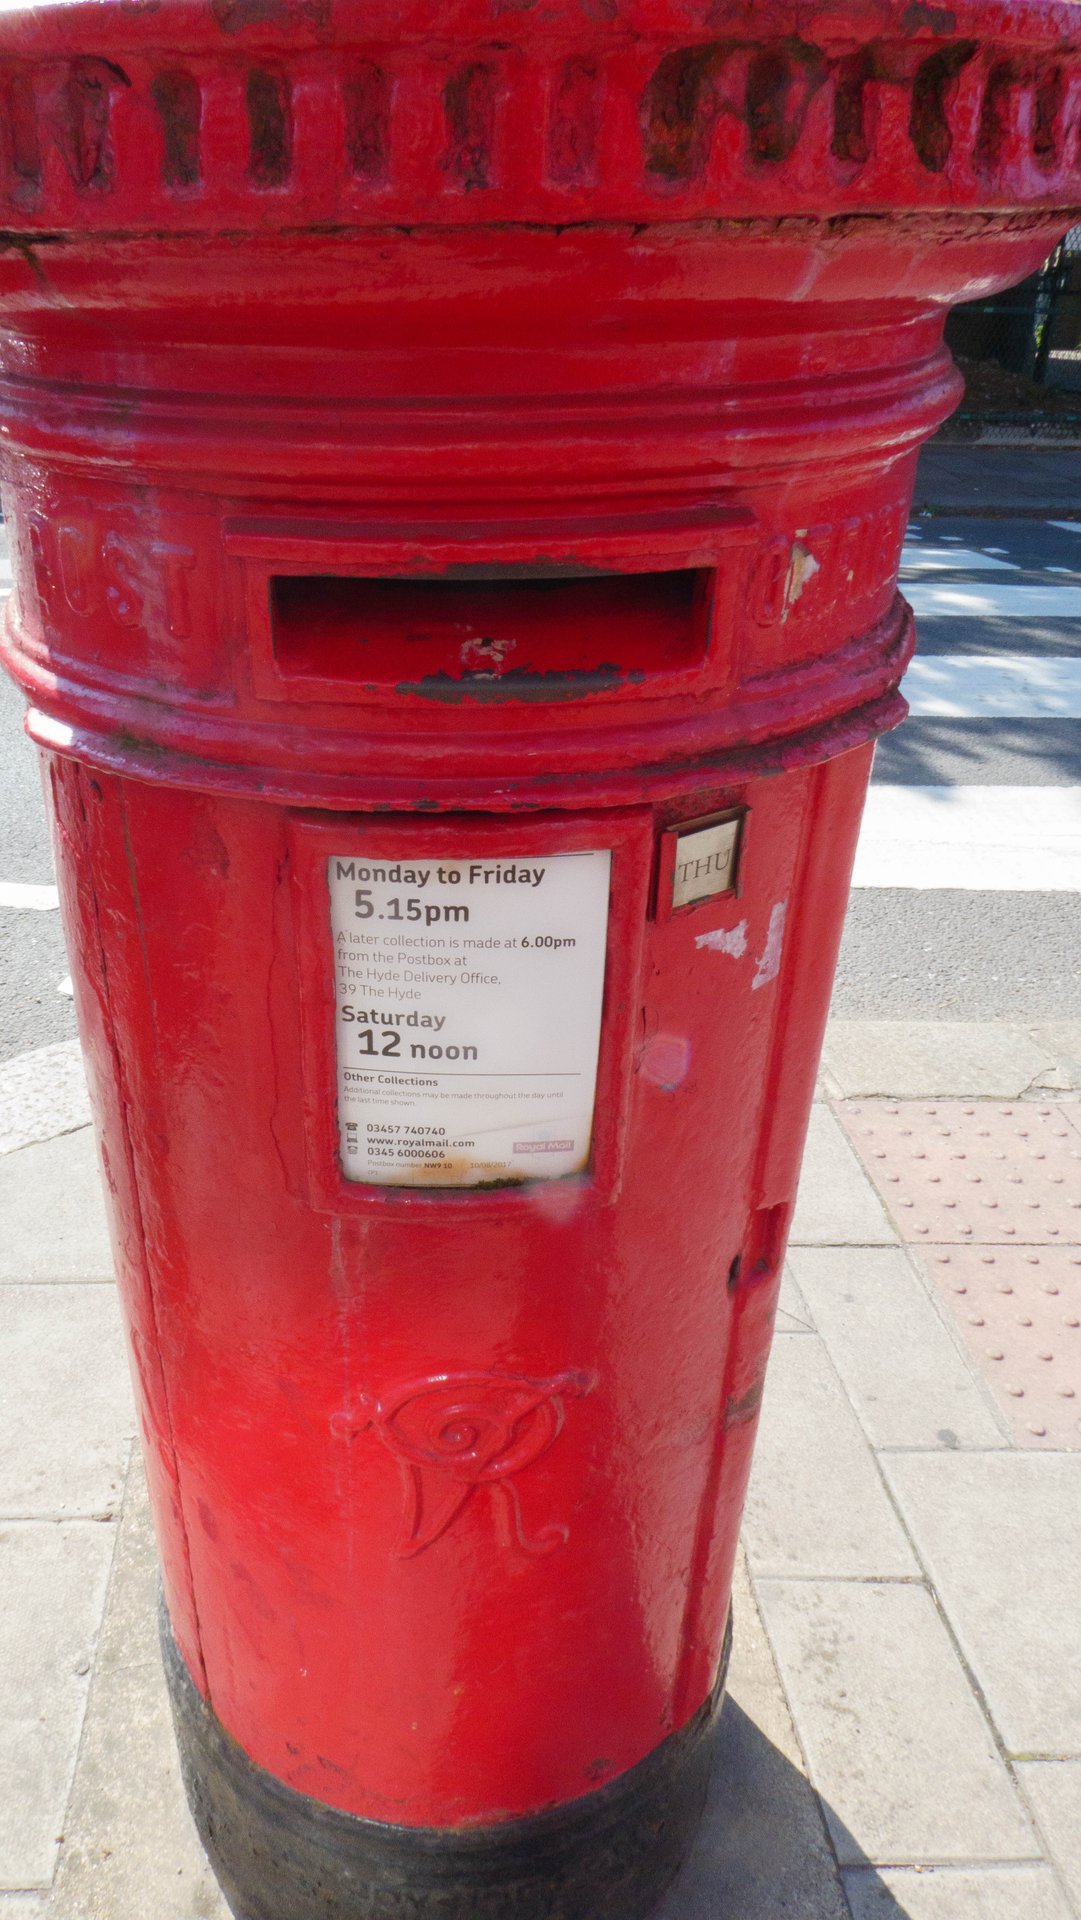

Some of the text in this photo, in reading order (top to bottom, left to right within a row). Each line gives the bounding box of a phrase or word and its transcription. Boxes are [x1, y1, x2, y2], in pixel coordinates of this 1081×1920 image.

[678, 848, 732, 883] THU
[336, 862, 546, 888] Monday to Friday
[354, 889, 470, 926] 5.15pm
[337, 931, 576, 950] A later collection is made at 6.00pm
[338, 949, 468, 967] from the Postbox at
[338, 965, 364, 979] The
[367, 968, 400, 983] Hyde
[404, 970, 457, 986] Delivery
[339, 982, 422, 1002] 39 The Hyde
[341, 1006, 447, 1031] Saturday
[357, 1029, 478, 1060] 12 noon
[343, 1071, 439, 1087] Other Collections
[343, 1086, 381, 1096] Additional
[382, 1090, 420, 1098] collections
[440, 1091, 450, 1099] be
[451, 1092, 473, 1100] made
[474, 1093, 516, 1101] throughout
[531, 1091, 545, 1100] day
[546, 1091, 564, 1099] until
[343, 1095, 357, 1103] the
[357, 1096, 371, 1104] last
[372, 1097, 389, 1105] time
[366, 1123, 446, 1136] 03457 740740
[367, 1137, 475, 1148] www.royalmail.com
[515, 1141, 572, 1152] Royal Mail
[367, 1147, 446, 1159] 0345 6000606
